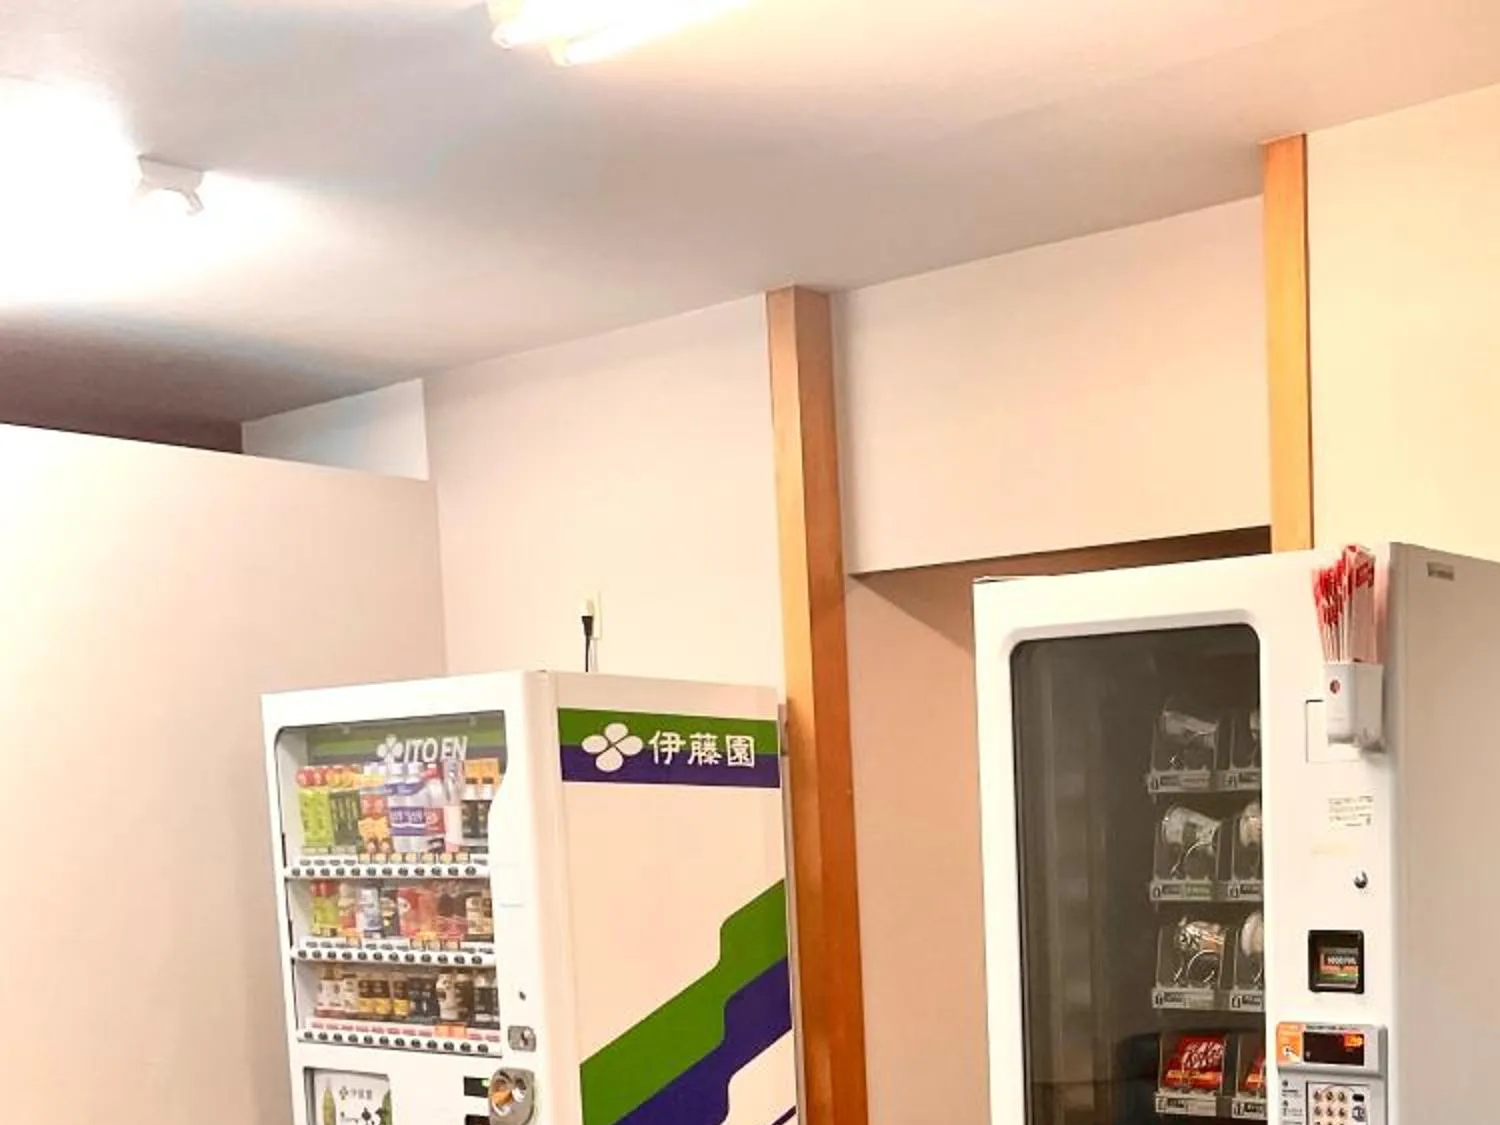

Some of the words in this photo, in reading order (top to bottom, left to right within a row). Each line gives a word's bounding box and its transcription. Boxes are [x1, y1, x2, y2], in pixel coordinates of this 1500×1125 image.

[404, 736, 438, 763] ITO
[441, 735, 468, 761] EN
[648, 729, 756, 769] 伊藤園
